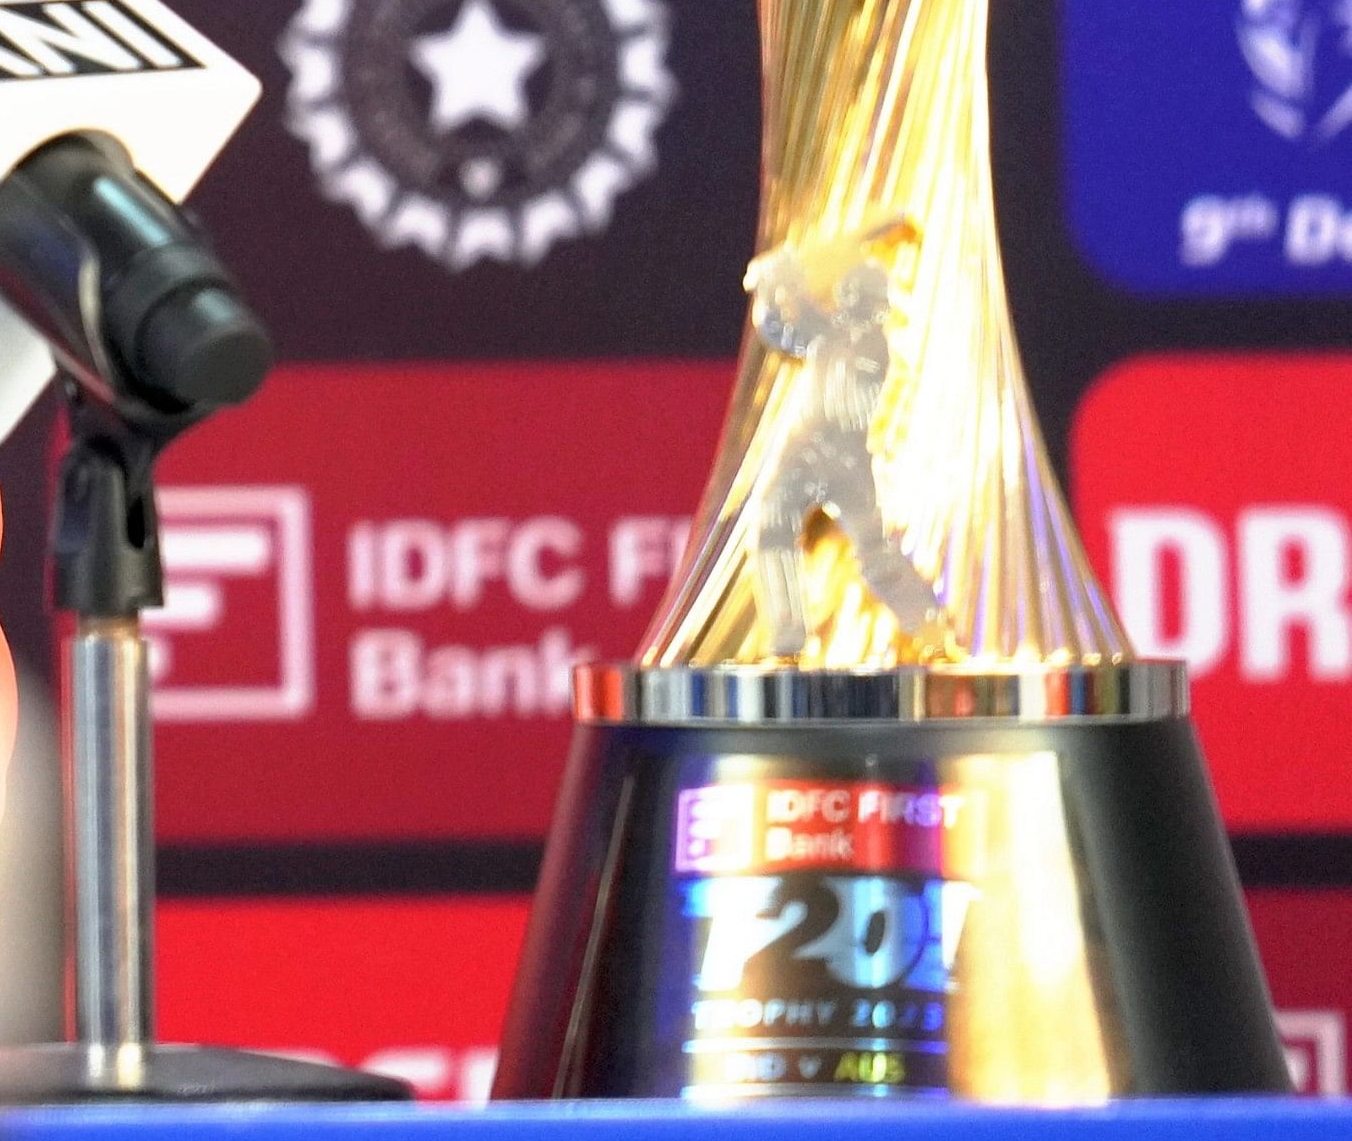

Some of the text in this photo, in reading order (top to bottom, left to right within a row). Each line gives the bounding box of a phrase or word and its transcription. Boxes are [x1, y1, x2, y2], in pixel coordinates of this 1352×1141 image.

[346, 515, 586, 611] IDFC
[766, 789, 965, 828] IDFC FIRST
[765, 827, 854, 860] Bank
